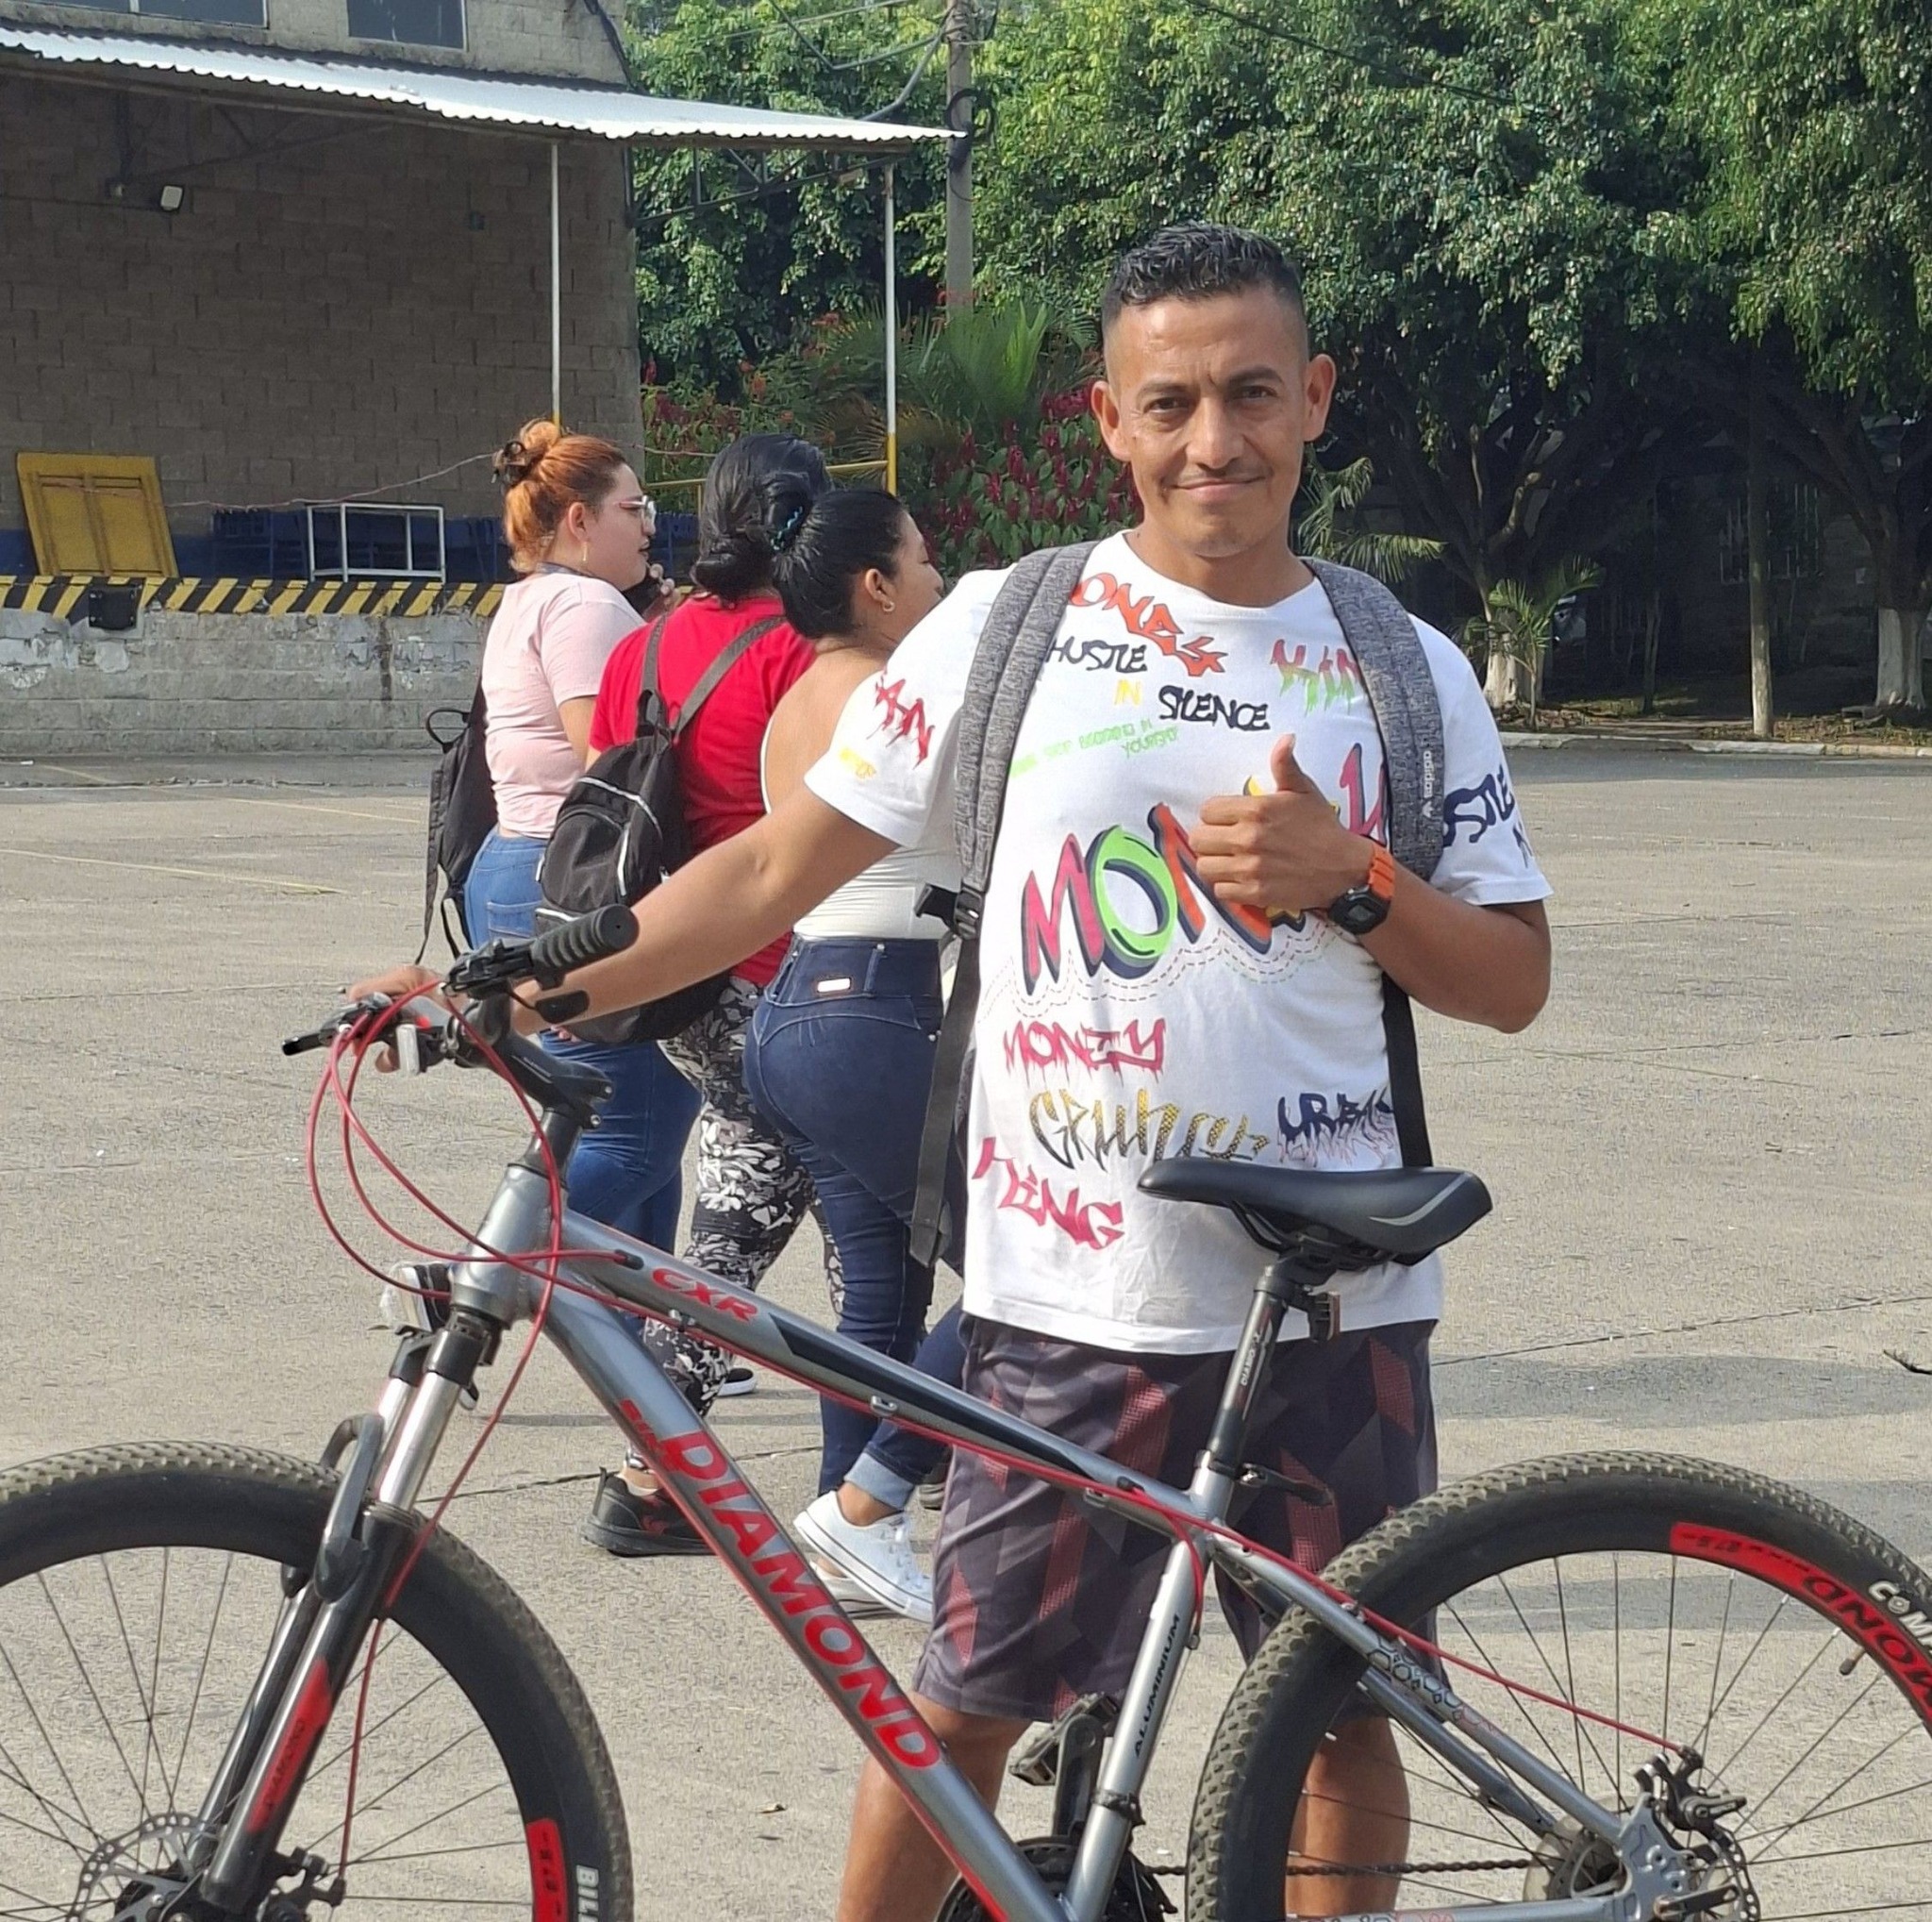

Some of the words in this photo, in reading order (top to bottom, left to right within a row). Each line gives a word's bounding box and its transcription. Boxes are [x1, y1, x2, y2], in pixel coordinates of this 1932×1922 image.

[1158, 684, 1271, 731] SILENCE
[652, 1267, 758, 1322] CXR
[660, 1430, 941, 1770] DIAMOND
